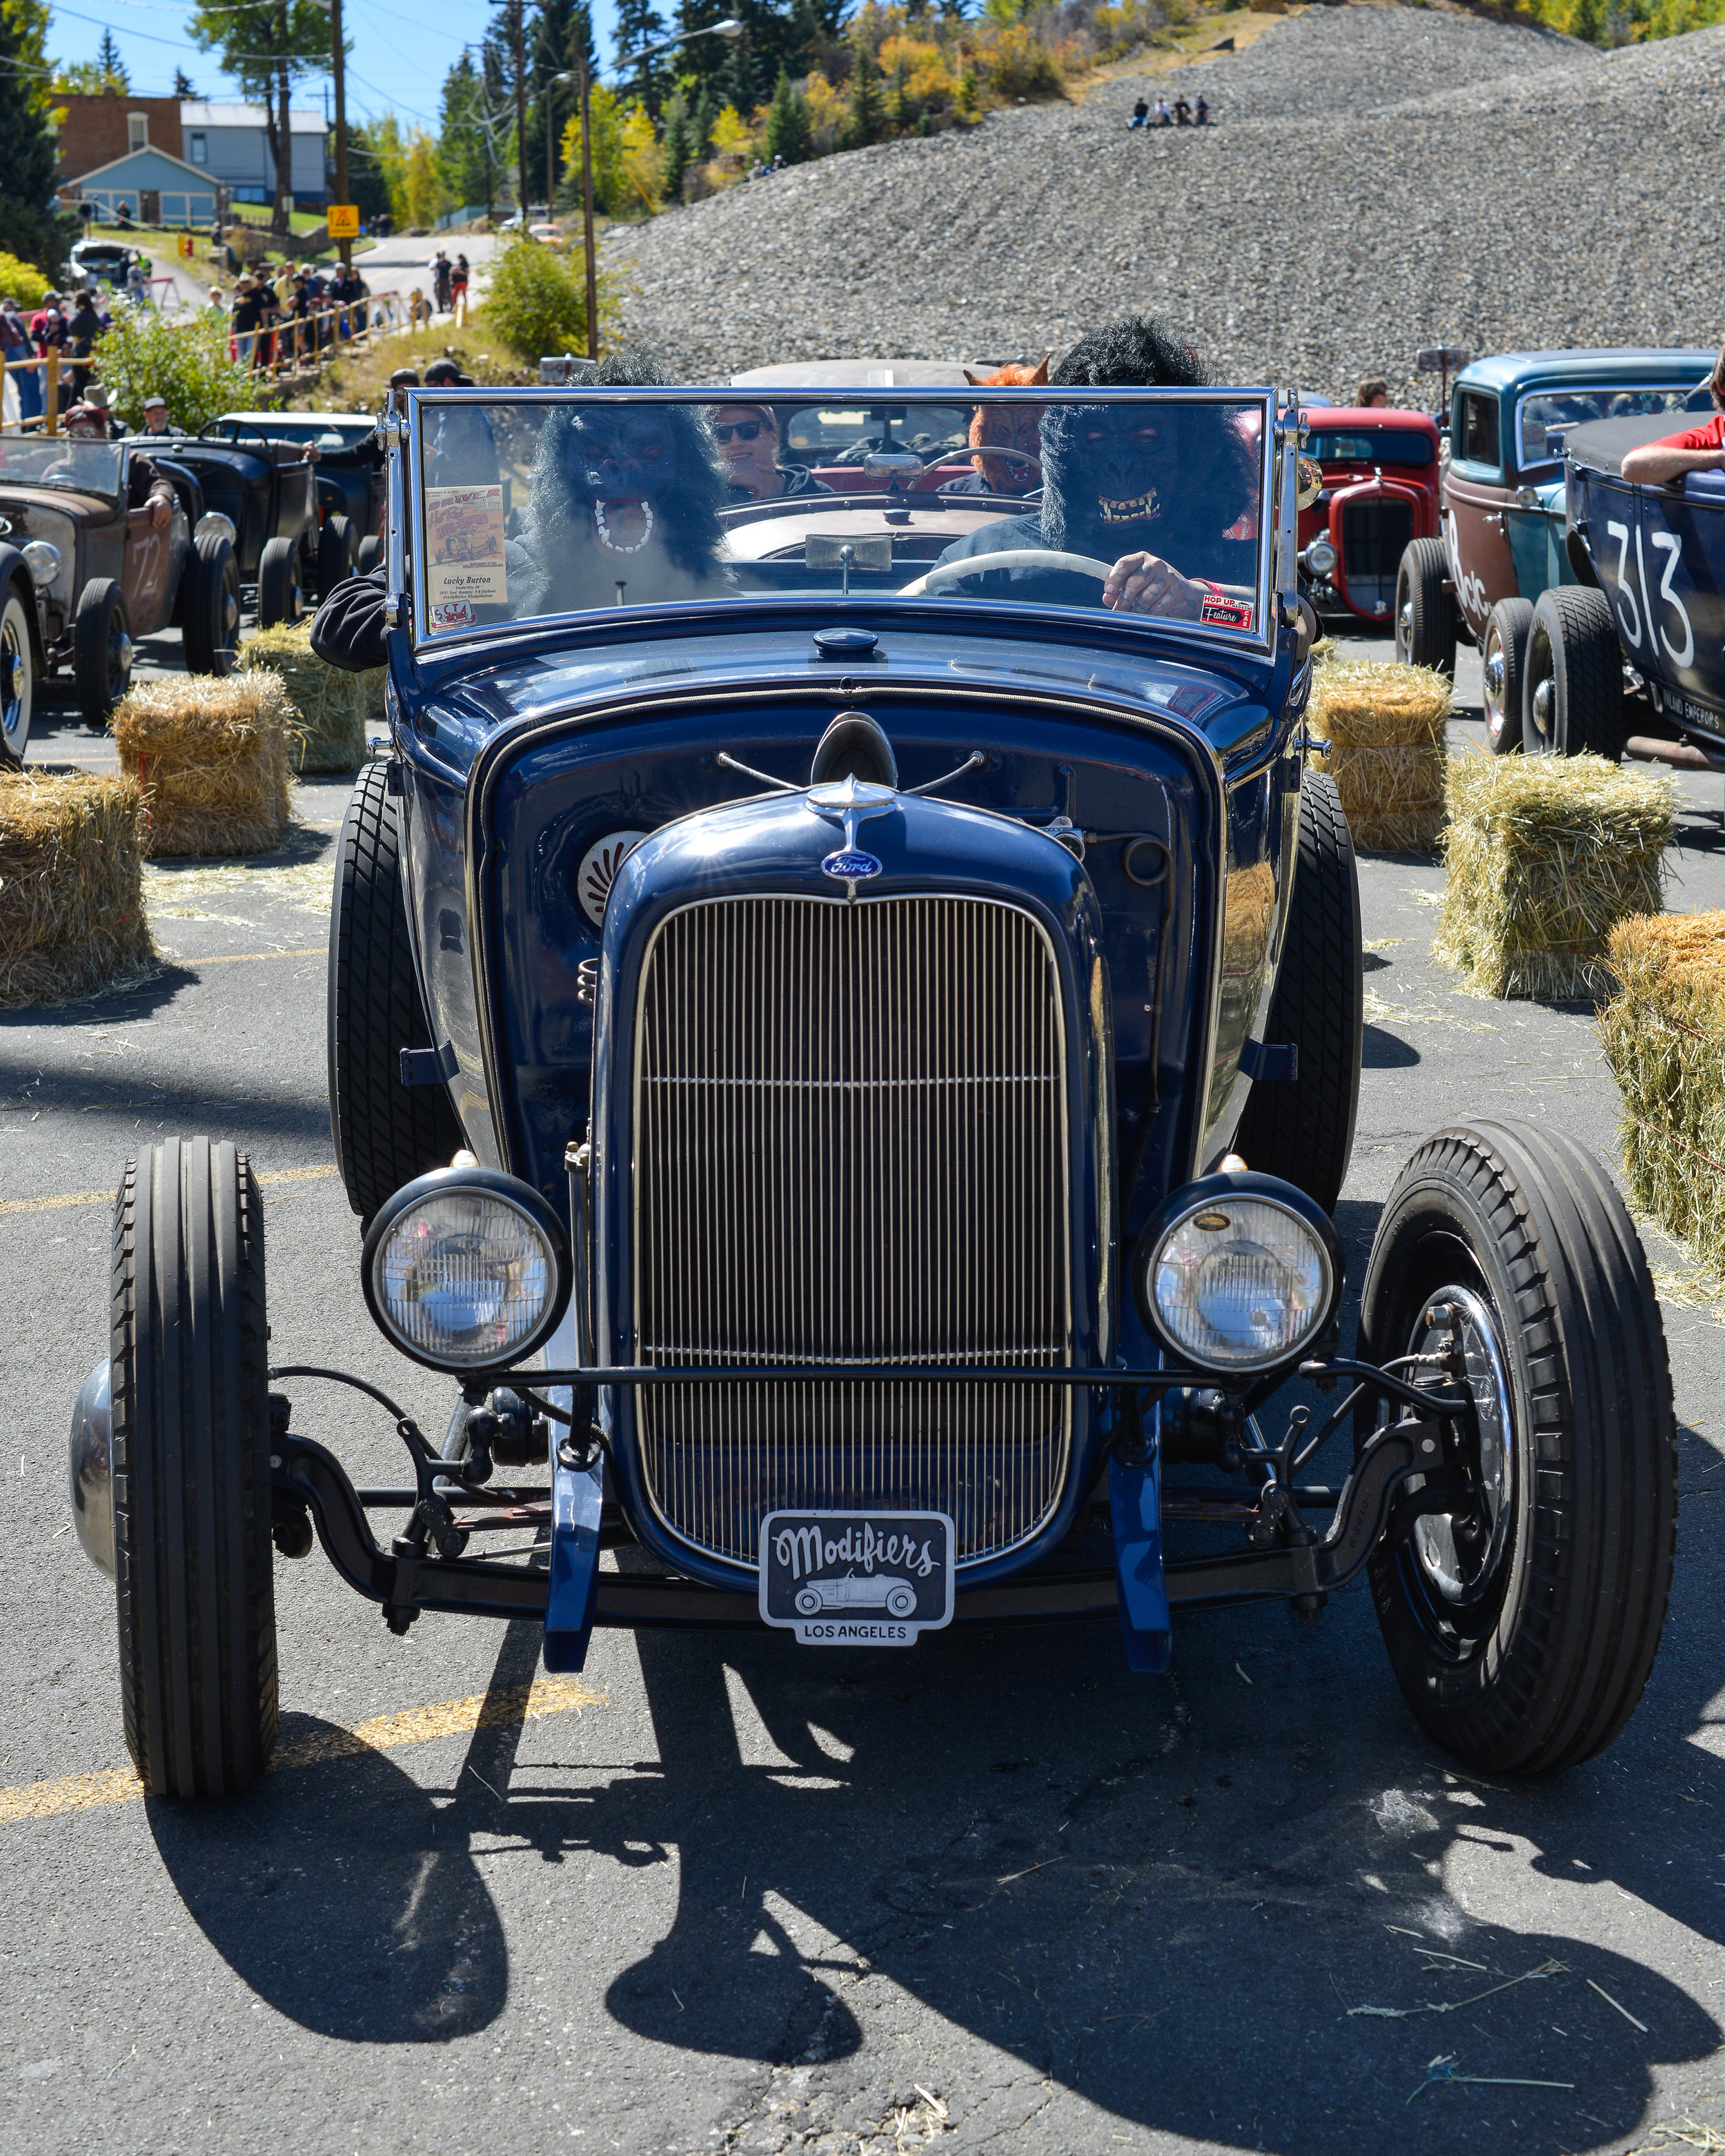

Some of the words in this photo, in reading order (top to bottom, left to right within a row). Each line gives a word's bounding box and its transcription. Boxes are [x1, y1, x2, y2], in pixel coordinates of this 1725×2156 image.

[428, 488, 500, 511] DRIVER
[132, 533, 160, 600] 72
[444, 577, 464, 586] Lucky
[1204, 595, 1221, 604] HOP
[1223, 597, 1235, 606] UP
[1607, 520, 1695, 669] 313
[1204, 607, 1236, 622] Feature
[1685, 702, 1719, 729] EMPERORS
[830, 855, 873, 873] Ford
[771, 1521, 940, 1581] Modifiers
[805, 1625, 834, 1637] LOS
[838, 1625, 907, 1639] ANGELES
